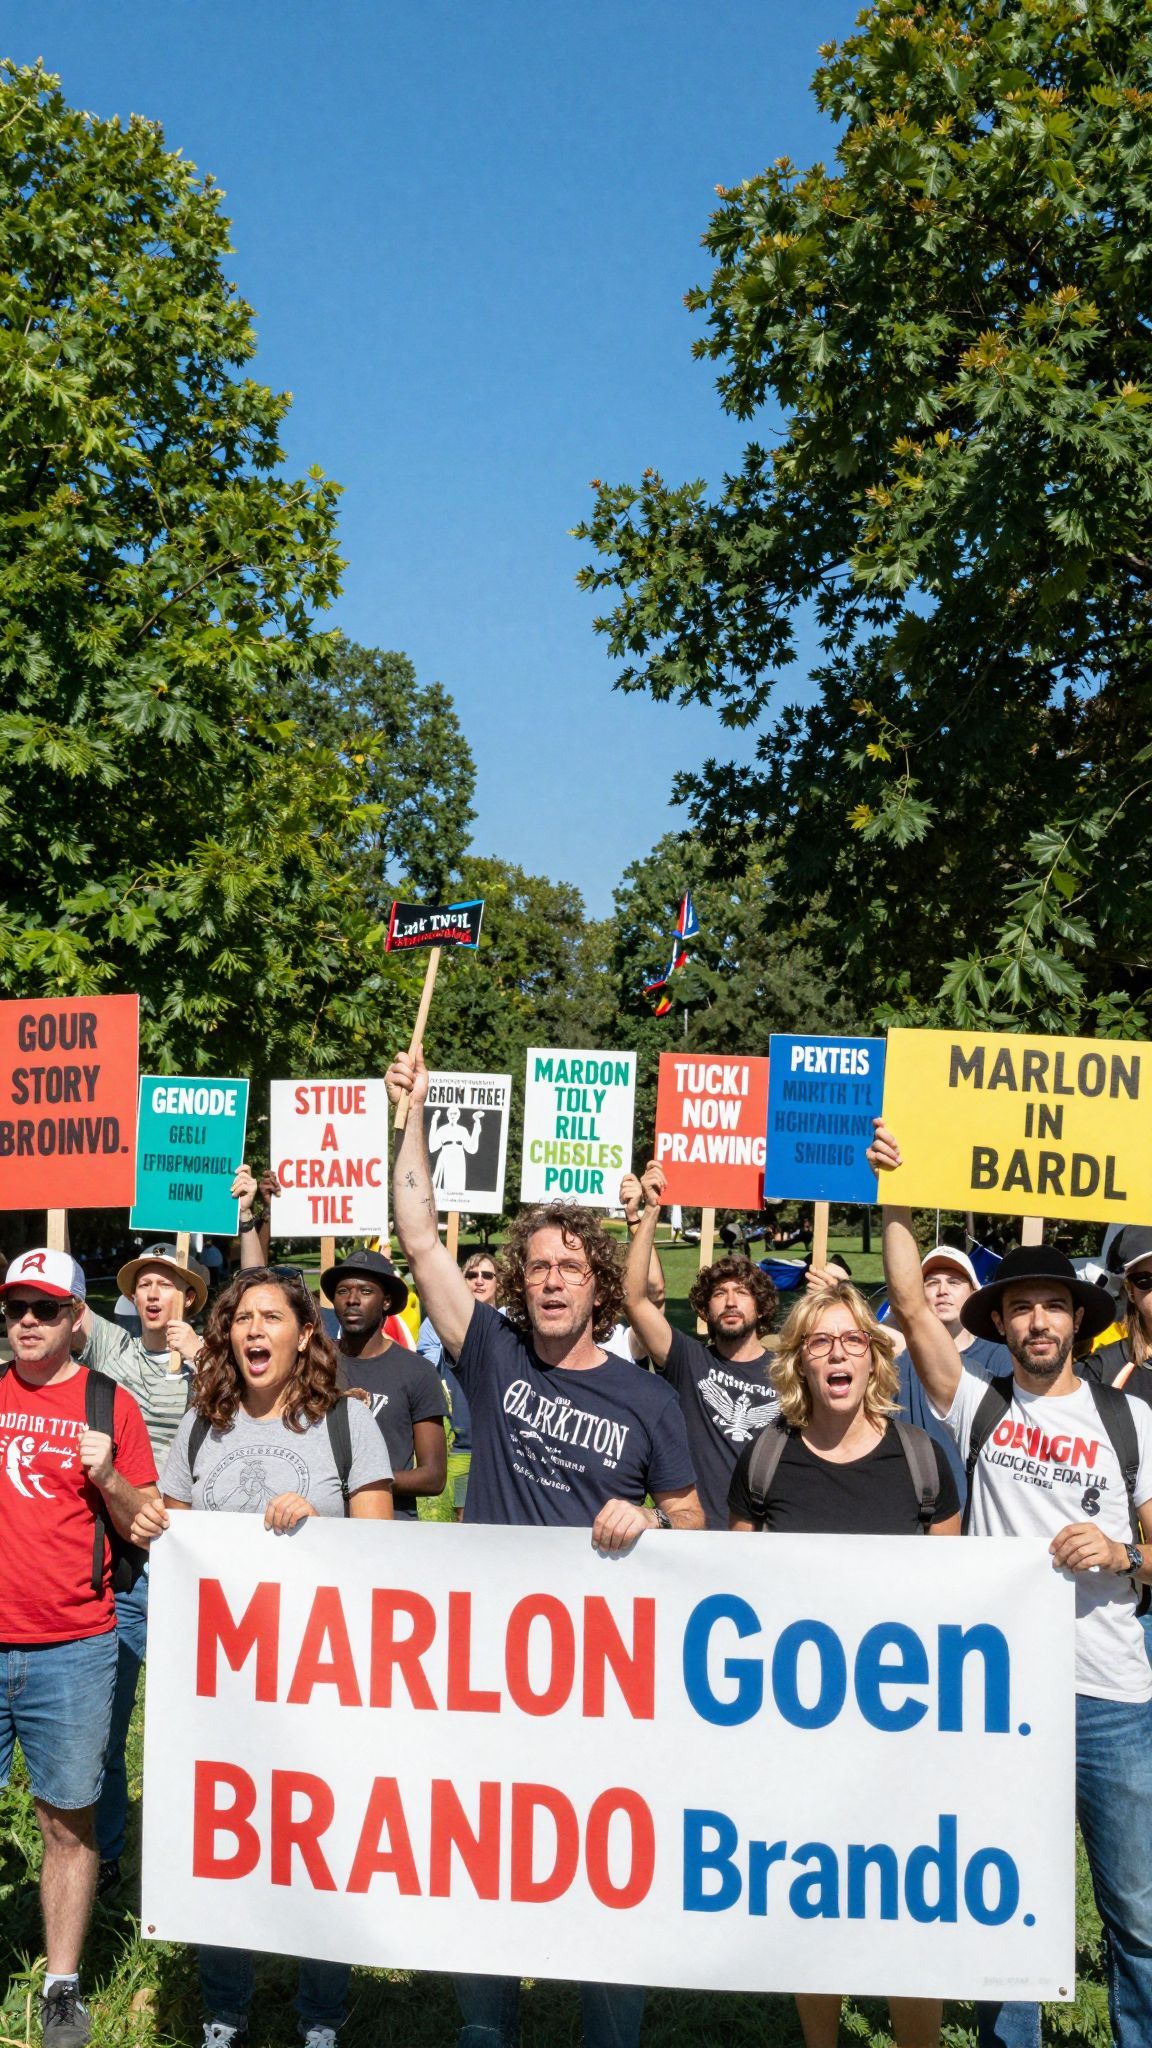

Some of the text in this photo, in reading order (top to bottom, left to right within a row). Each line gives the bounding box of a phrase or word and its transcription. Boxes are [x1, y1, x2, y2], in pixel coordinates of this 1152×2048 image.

[18, 1012, 98, 1052] GOUR
[534, 1057, 630, 1087] MARDON
[790, 1045, 870, 1075] PEXTEIS
[949, 1045, 1141, 1100] MARLON
[11, 1065, 100, 1105] STORY
[674, 1063, 749, 1095] TUCKI
[152, 1087, 238, 1117] GENODE
[295, 1086, 366, 1115] STIUE
[555, 1087, 607, 1113] TOLY
[682, 1098, 742, 1130] NOW
[320, 1123, 339, 1151] A
[556, 1116, 600, 1140] RILL
[1024, 1103, 1064, 1140] IN
[656, 1133, 767, 1166] PRAWING
[277, 1158, 382, 1188] CERANC
[545, 1167, 604, 1194] POUR
[971, 1146, 1127, 1201] BARDL
[307, 1196, 354, 1224] TILE
[197, 1578, 1031, 1736] MARLON Goen.
[193, 1761, 1036, 1927] BRANDO Brando.
